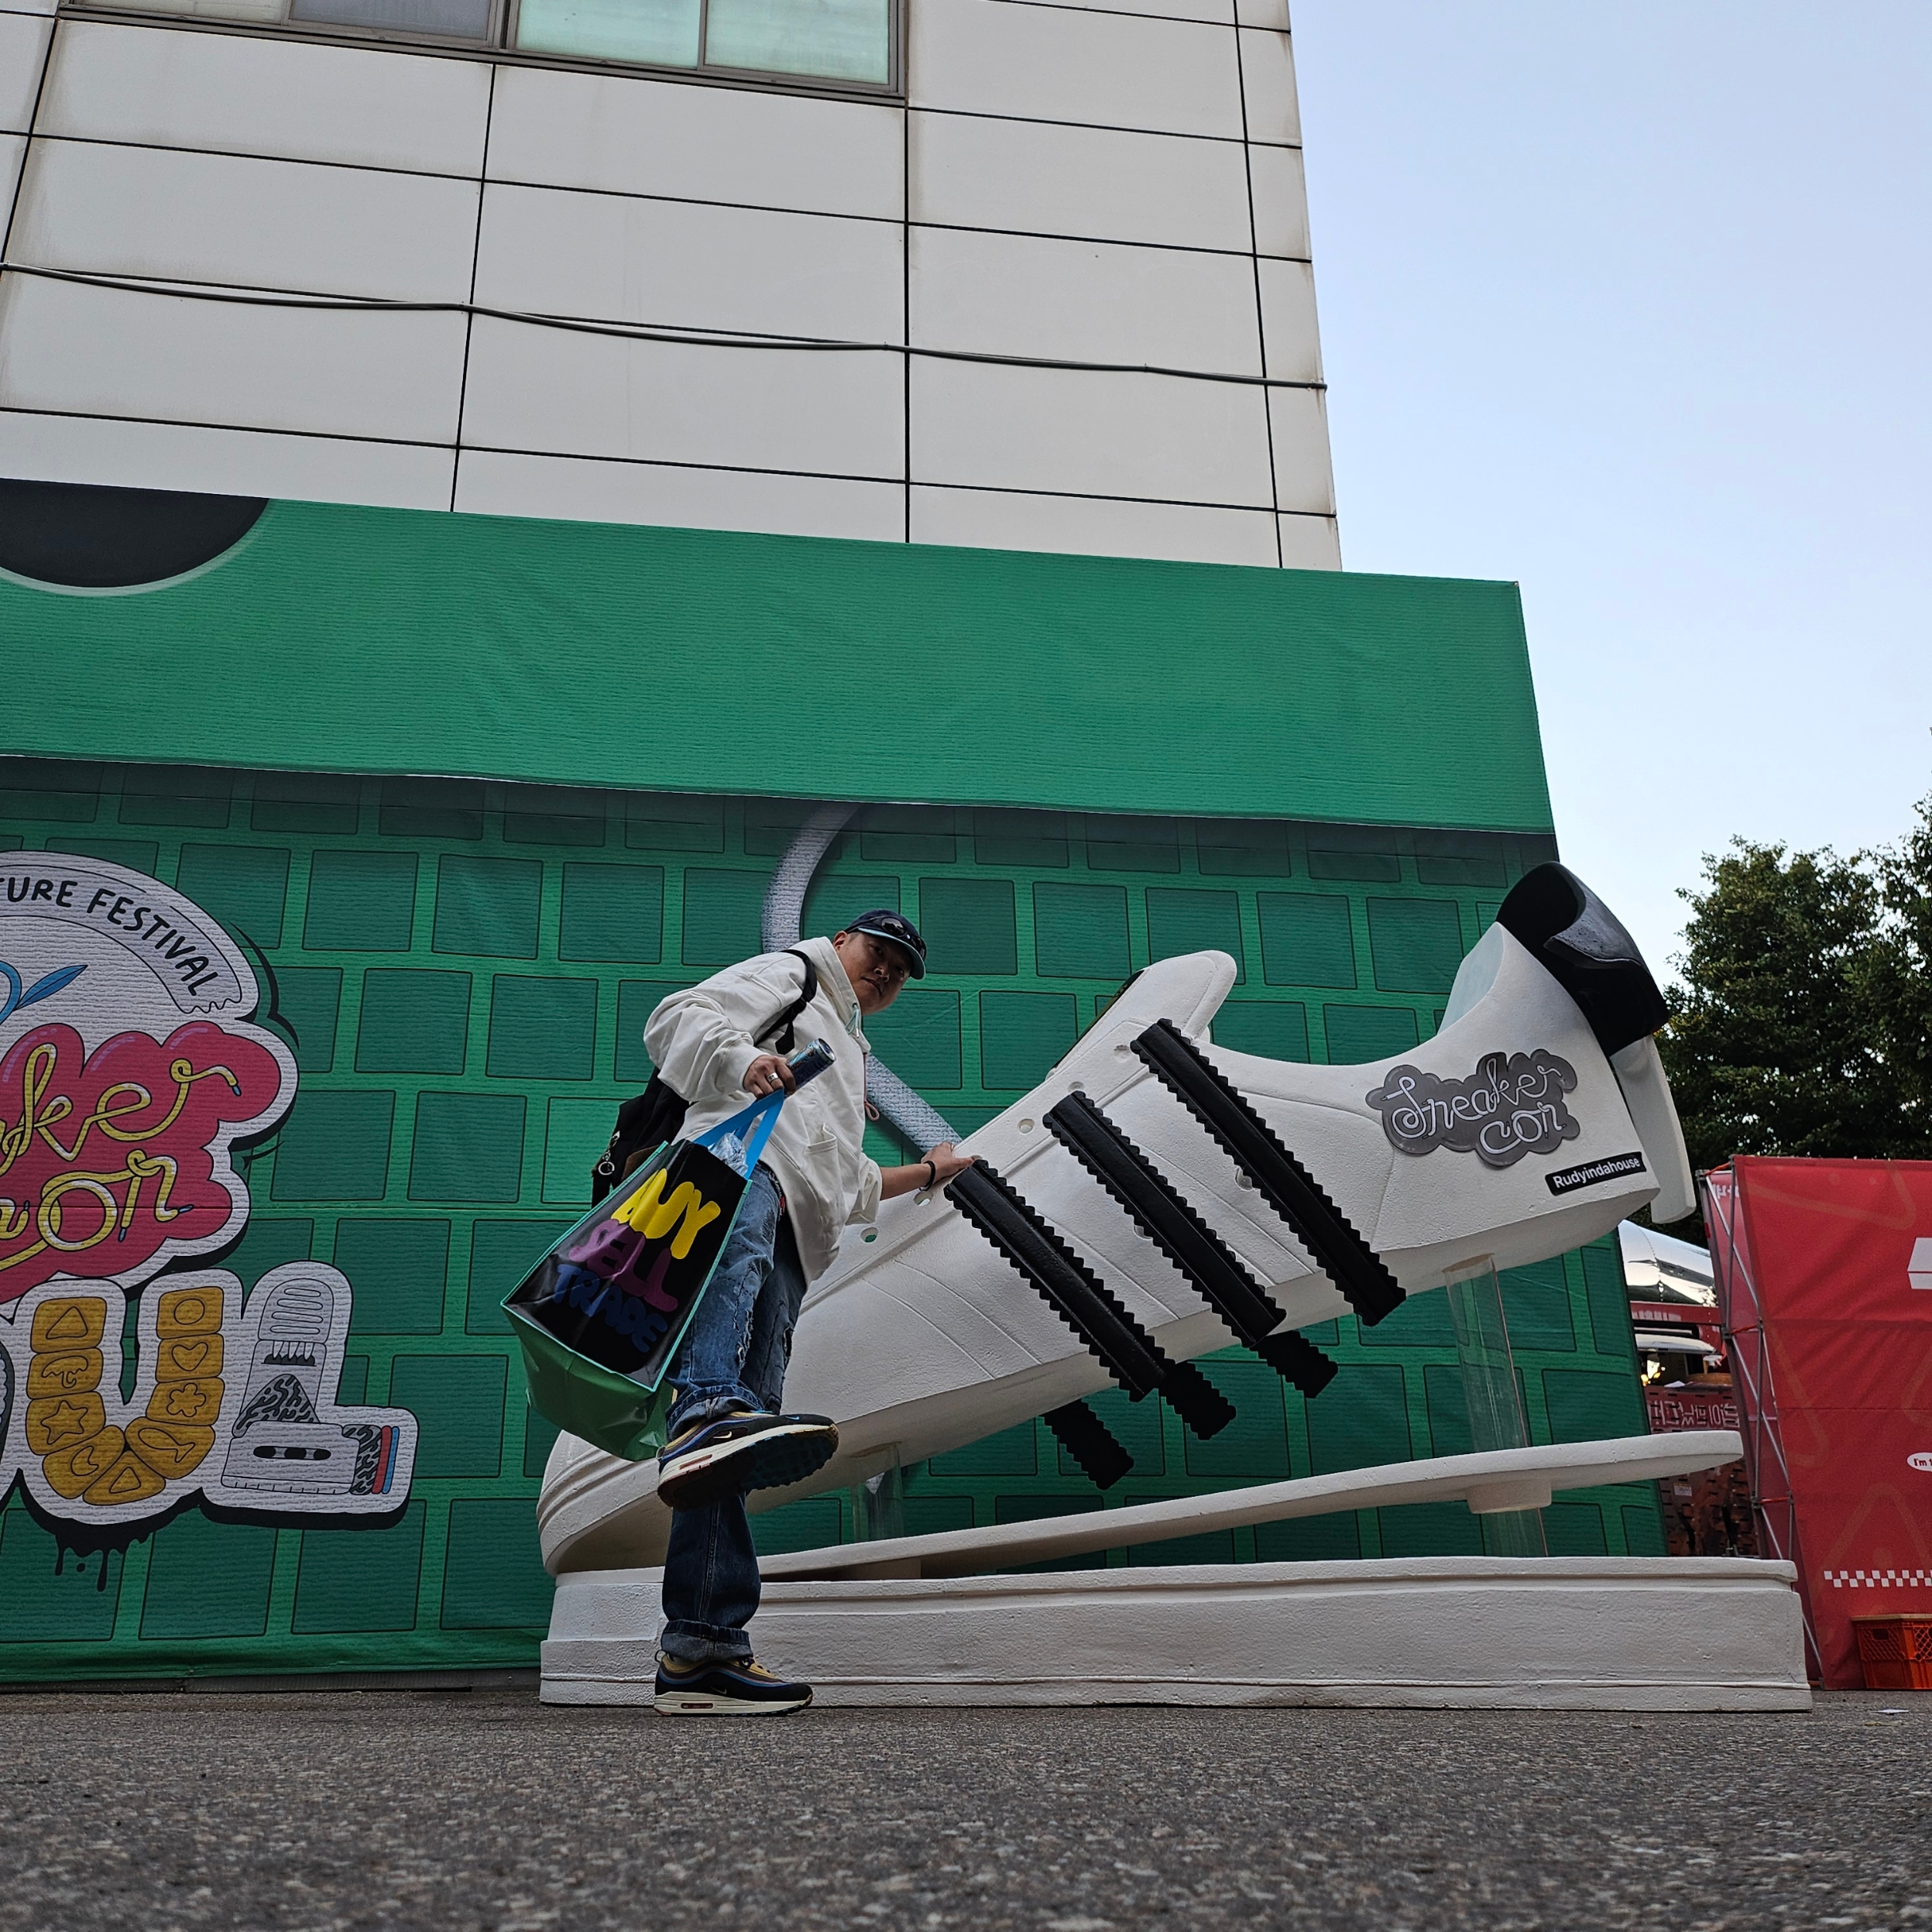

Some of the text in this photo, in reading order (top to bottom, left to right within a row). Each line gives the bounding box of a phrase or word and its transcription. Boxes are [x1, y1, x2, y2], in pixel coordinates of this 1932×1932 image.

[0, 876, 218, 997] URE FESTIVAL
[0, 1042, 242, 1176] ker
[1381, 1057, 1566, 1140] Sneaker
[609, 1167, 722, 1260] BUY
[1552, 1157, 1641, 1189] Rudyindahouse
[552, 1263, 668, 1354] TRADE
[568, 1219, 678, 1313] SELL
[0, 1259, 419, 1525] UL
